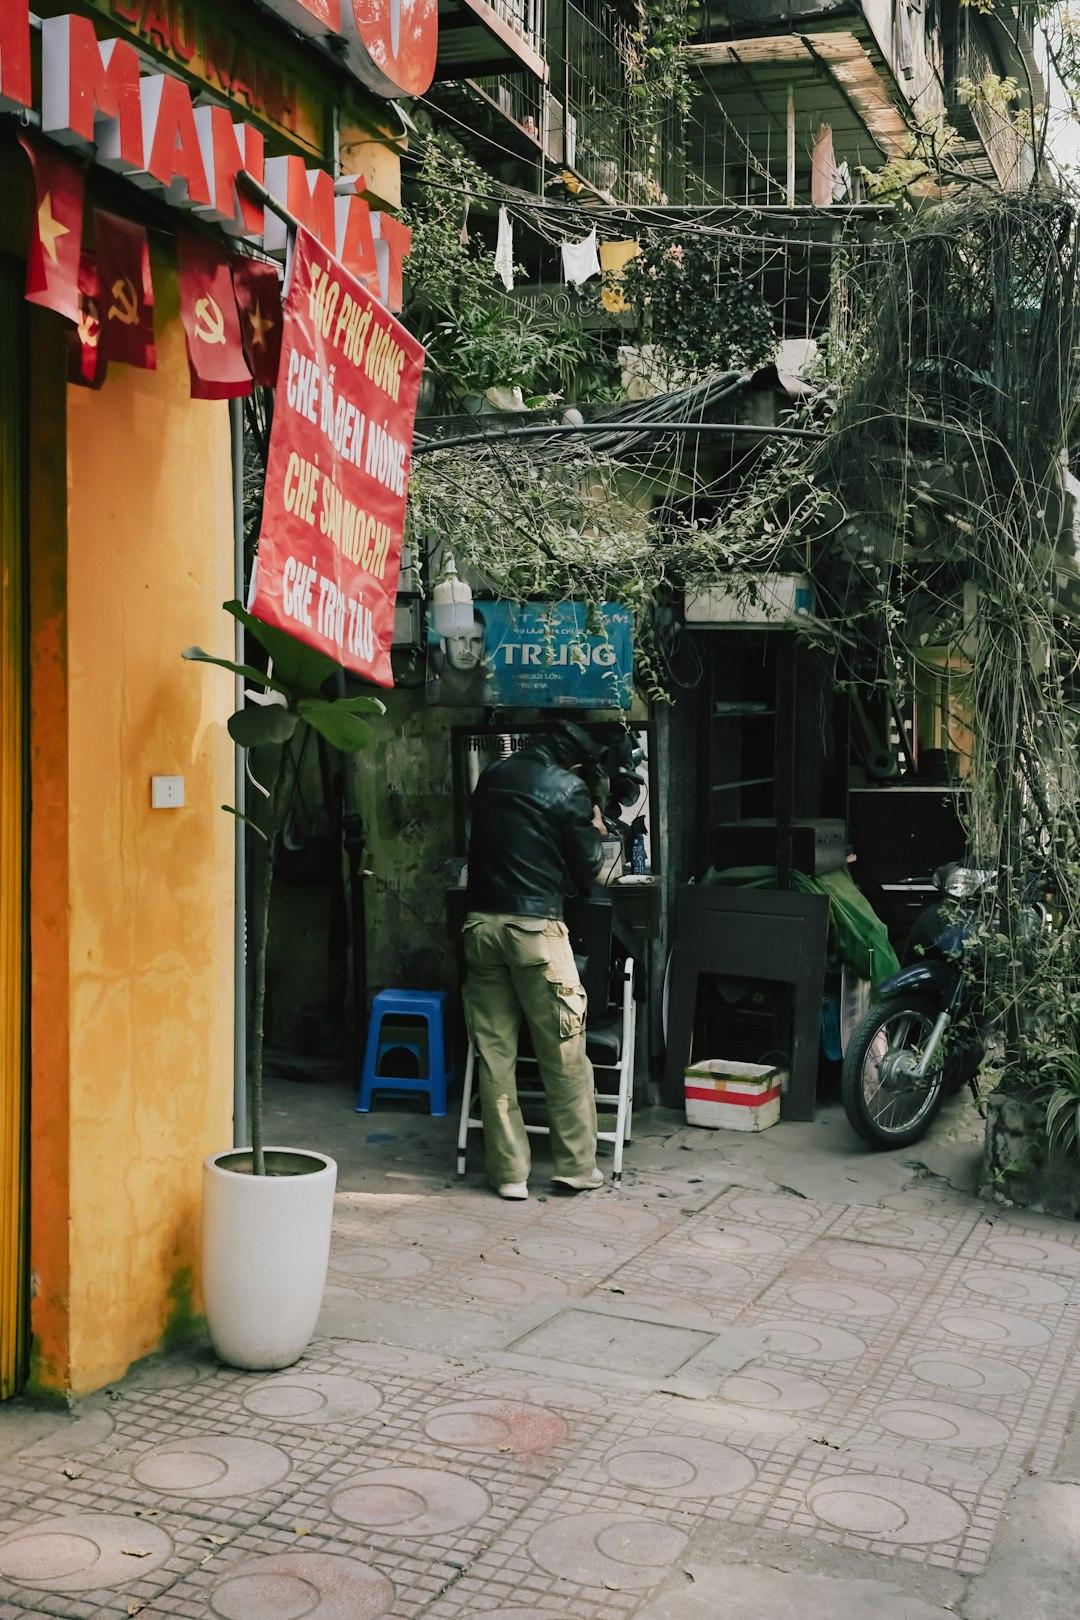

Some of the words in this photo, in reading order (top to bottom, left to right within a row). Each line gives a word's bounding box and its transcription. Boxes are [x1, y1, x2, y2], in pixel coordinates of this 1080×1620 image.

[333, 293, 374, 367] PHỚ
[365, 322, 406, 404] NÓNG
[287, 348, 320, 426] CHÈ
[365, 419, 407, 498] NÓNG
[283, 451, 320, 526] CHÈ
[340, 499, 391, 581] MOCHI
[282, 555, 318, 629] CHÈ
[347, 591, 375, 663] TÀU
[499, 643, 616, 667] TRUNG
